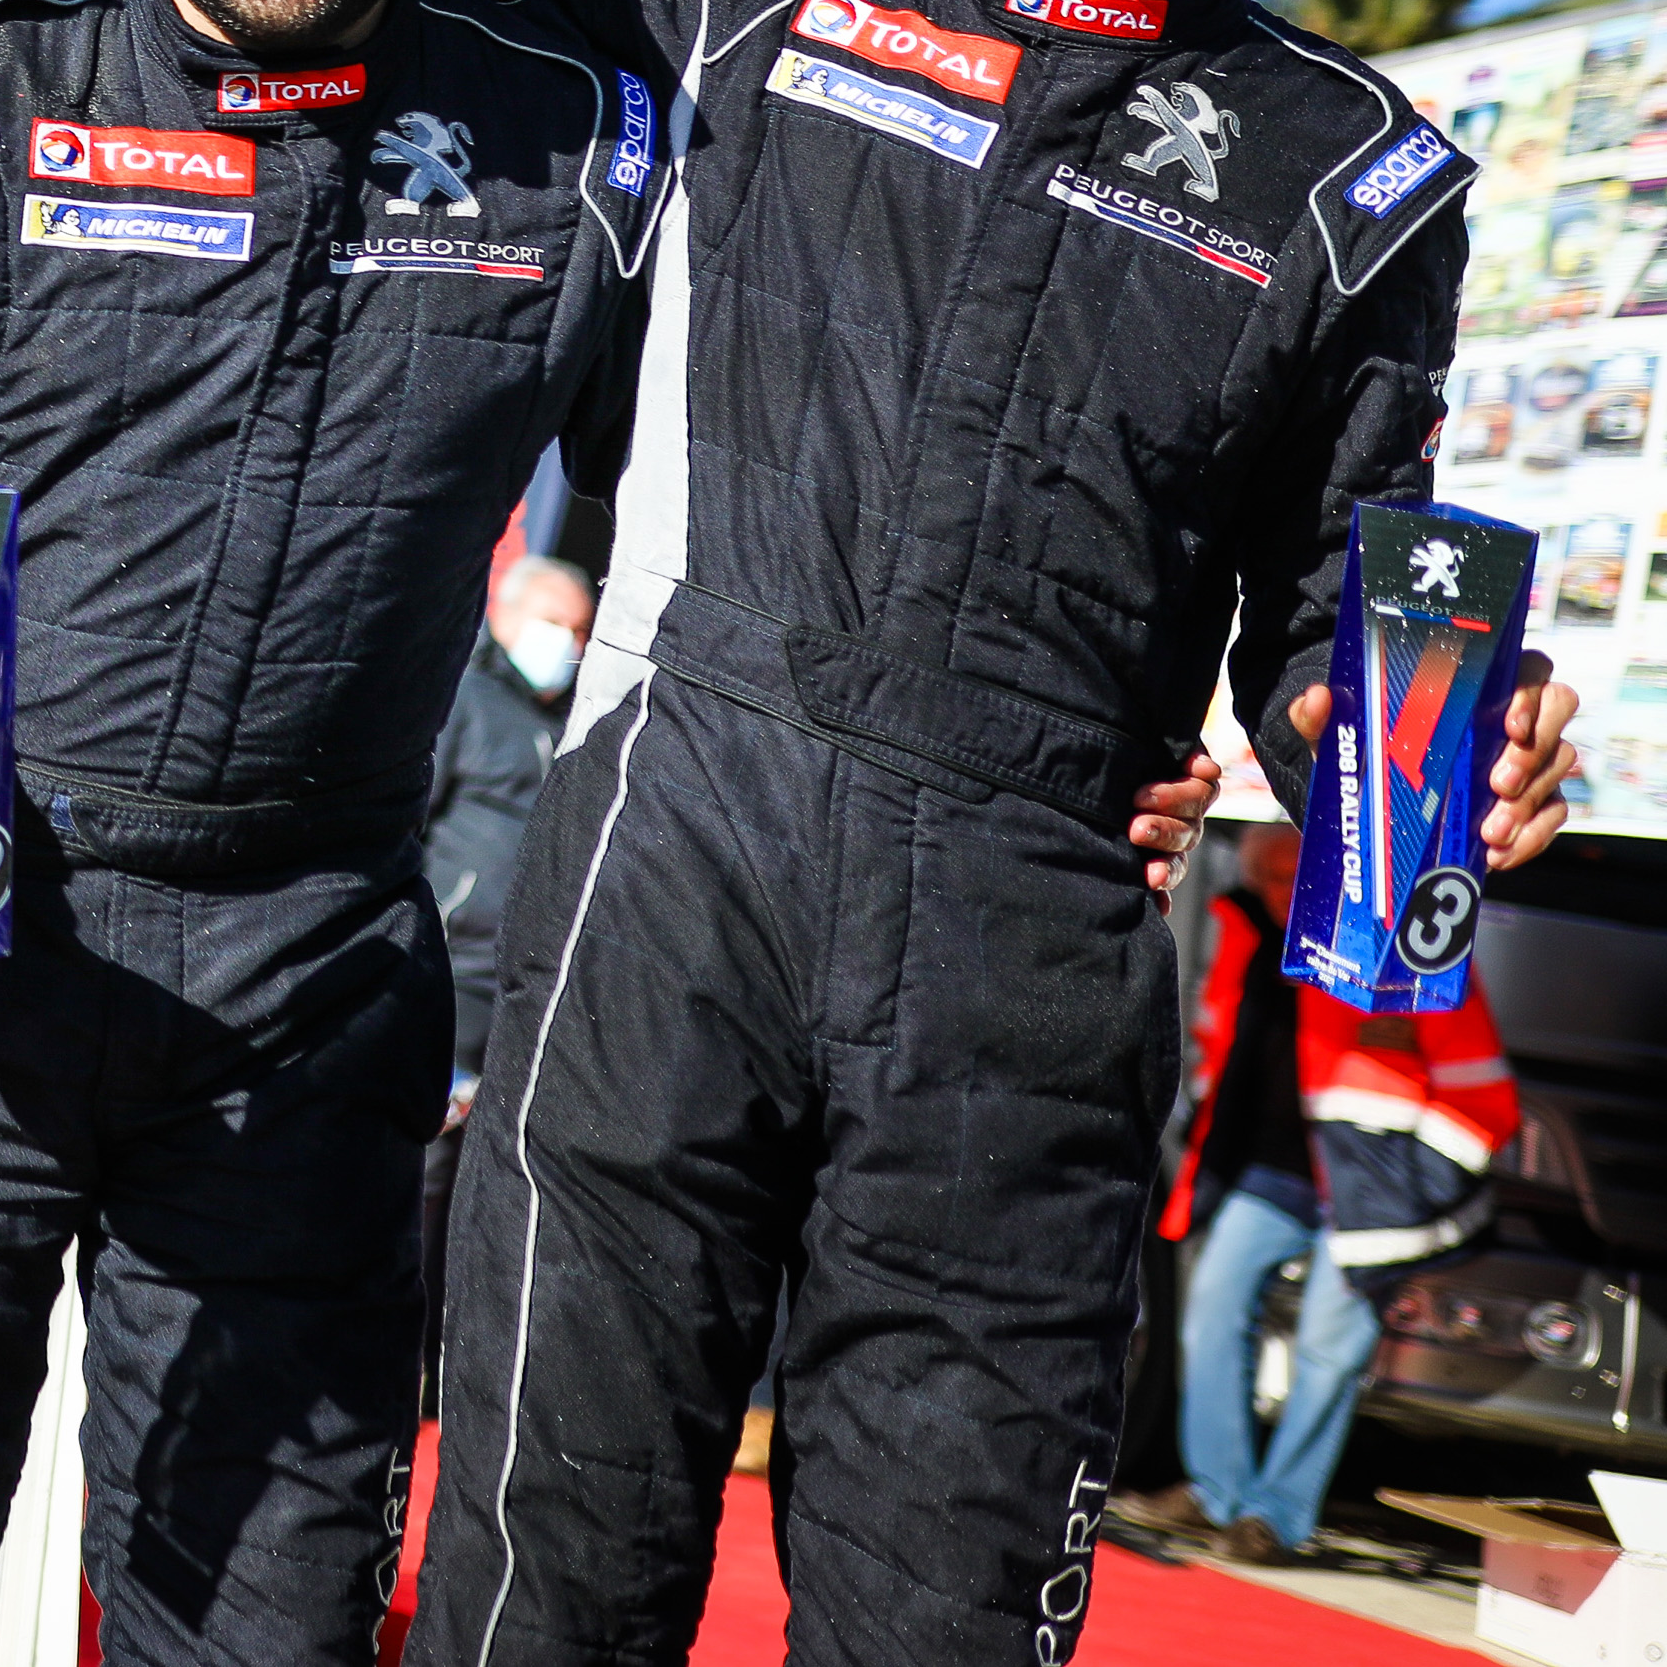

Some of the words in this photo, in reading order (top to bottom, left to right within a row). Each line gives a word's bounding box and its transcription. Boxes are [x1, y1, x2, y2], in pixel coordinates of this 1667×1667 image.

[867, 17, 1001, 86] TOTAL
[264, 79, 360, 100] TOTAL
[828, 80, 967, 145] MICHELIN
[93, 141, 245, 179] TOTAL
[613, 72, 647, 187] sparco
[1352, 127, 1445, 210] sparco
[87, 217, 230, 245] MICHELIN
[1056, 164, 1202, 236] PEUGEOT
[1204, 227, 1278, 271] SPORT
[331, 238, 476, 258] PEUGEOT
[476, 243, 545, 264] SPORT
[1375, 594, 1455, 617] PEUGEOT
[1336, 723, 1359, 772] 208
[1338, 774, 1361, 852] RALLY
[1342, 850, 1363, 904] CUP
[1407, 877, 1473, 963] 3
[1035, 1458, 1109, 1667] PORT
